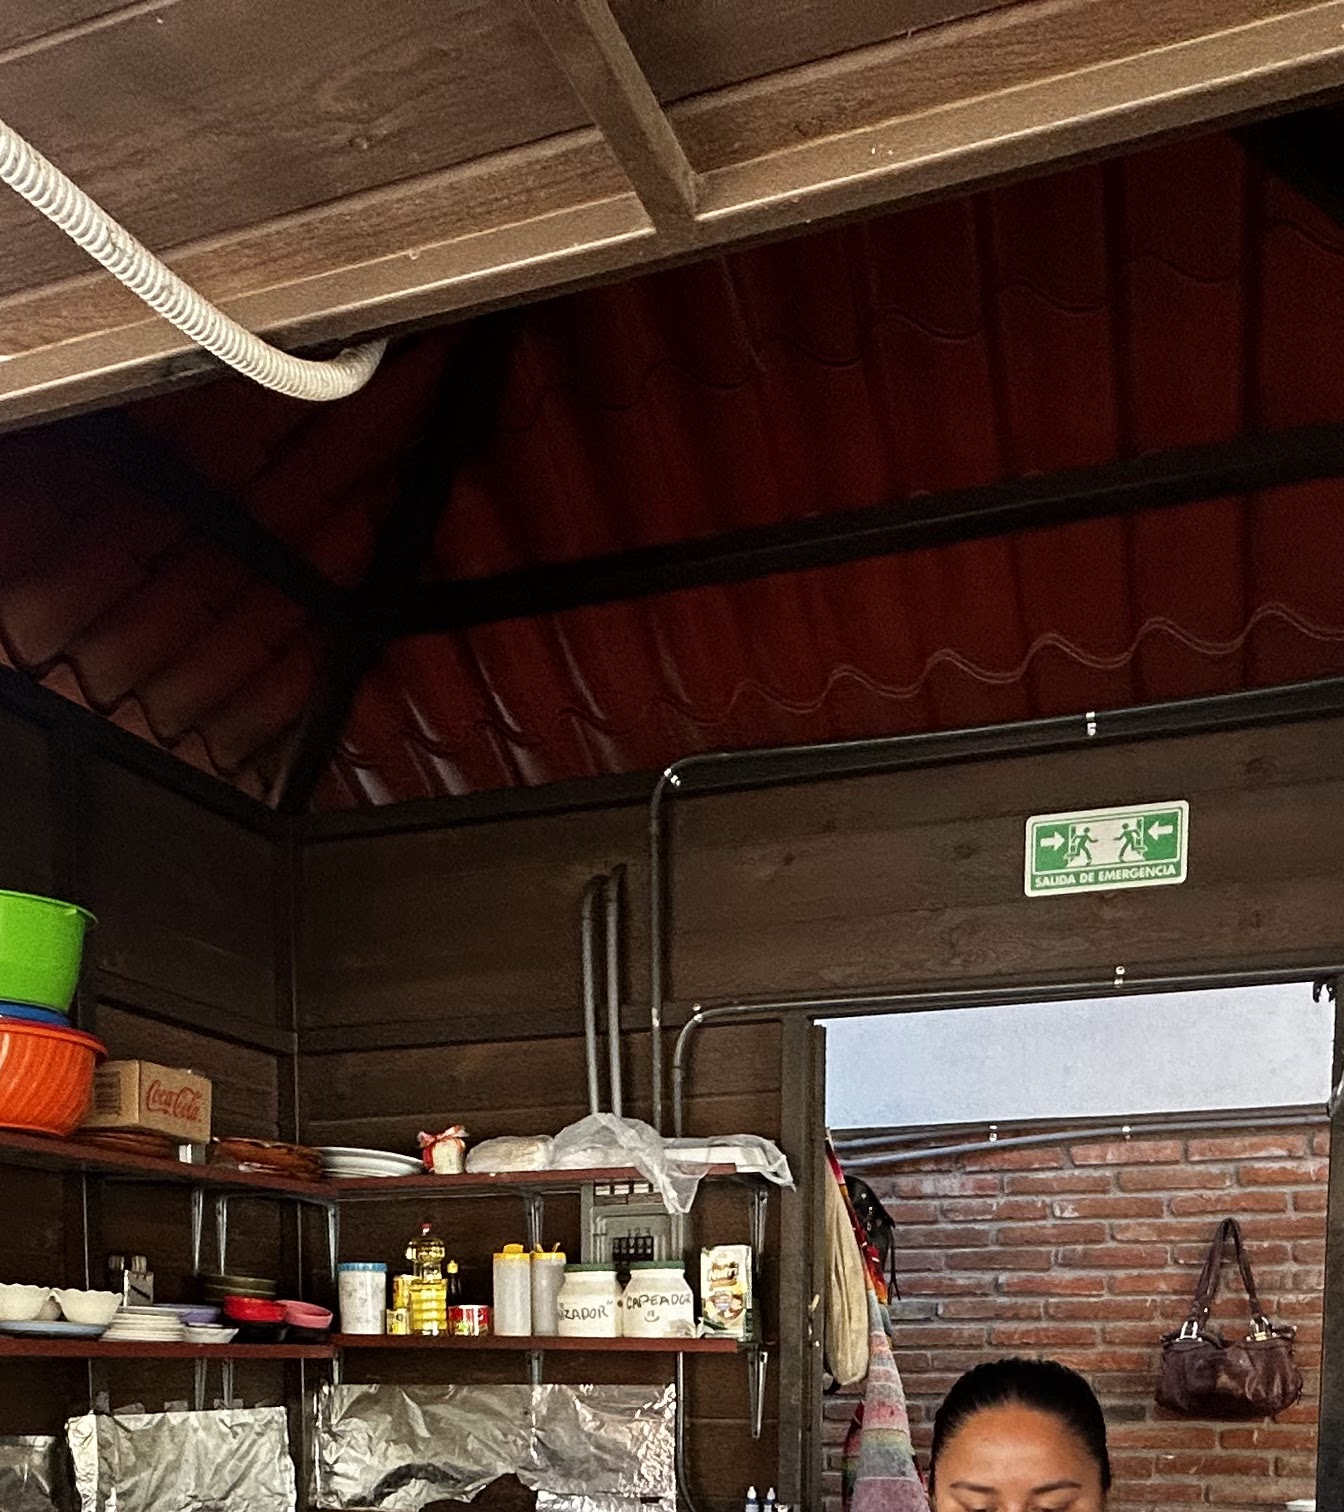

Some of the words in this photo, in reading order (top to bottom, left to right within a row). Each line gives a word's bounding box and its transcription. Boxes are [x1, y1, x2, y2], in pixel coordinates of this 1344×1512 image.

[1035, 873, 1076, 888] SALIDA
[1079, 871, 1095, 883] DE
[1098, 864, 1176, 882] EMERGENCIA
